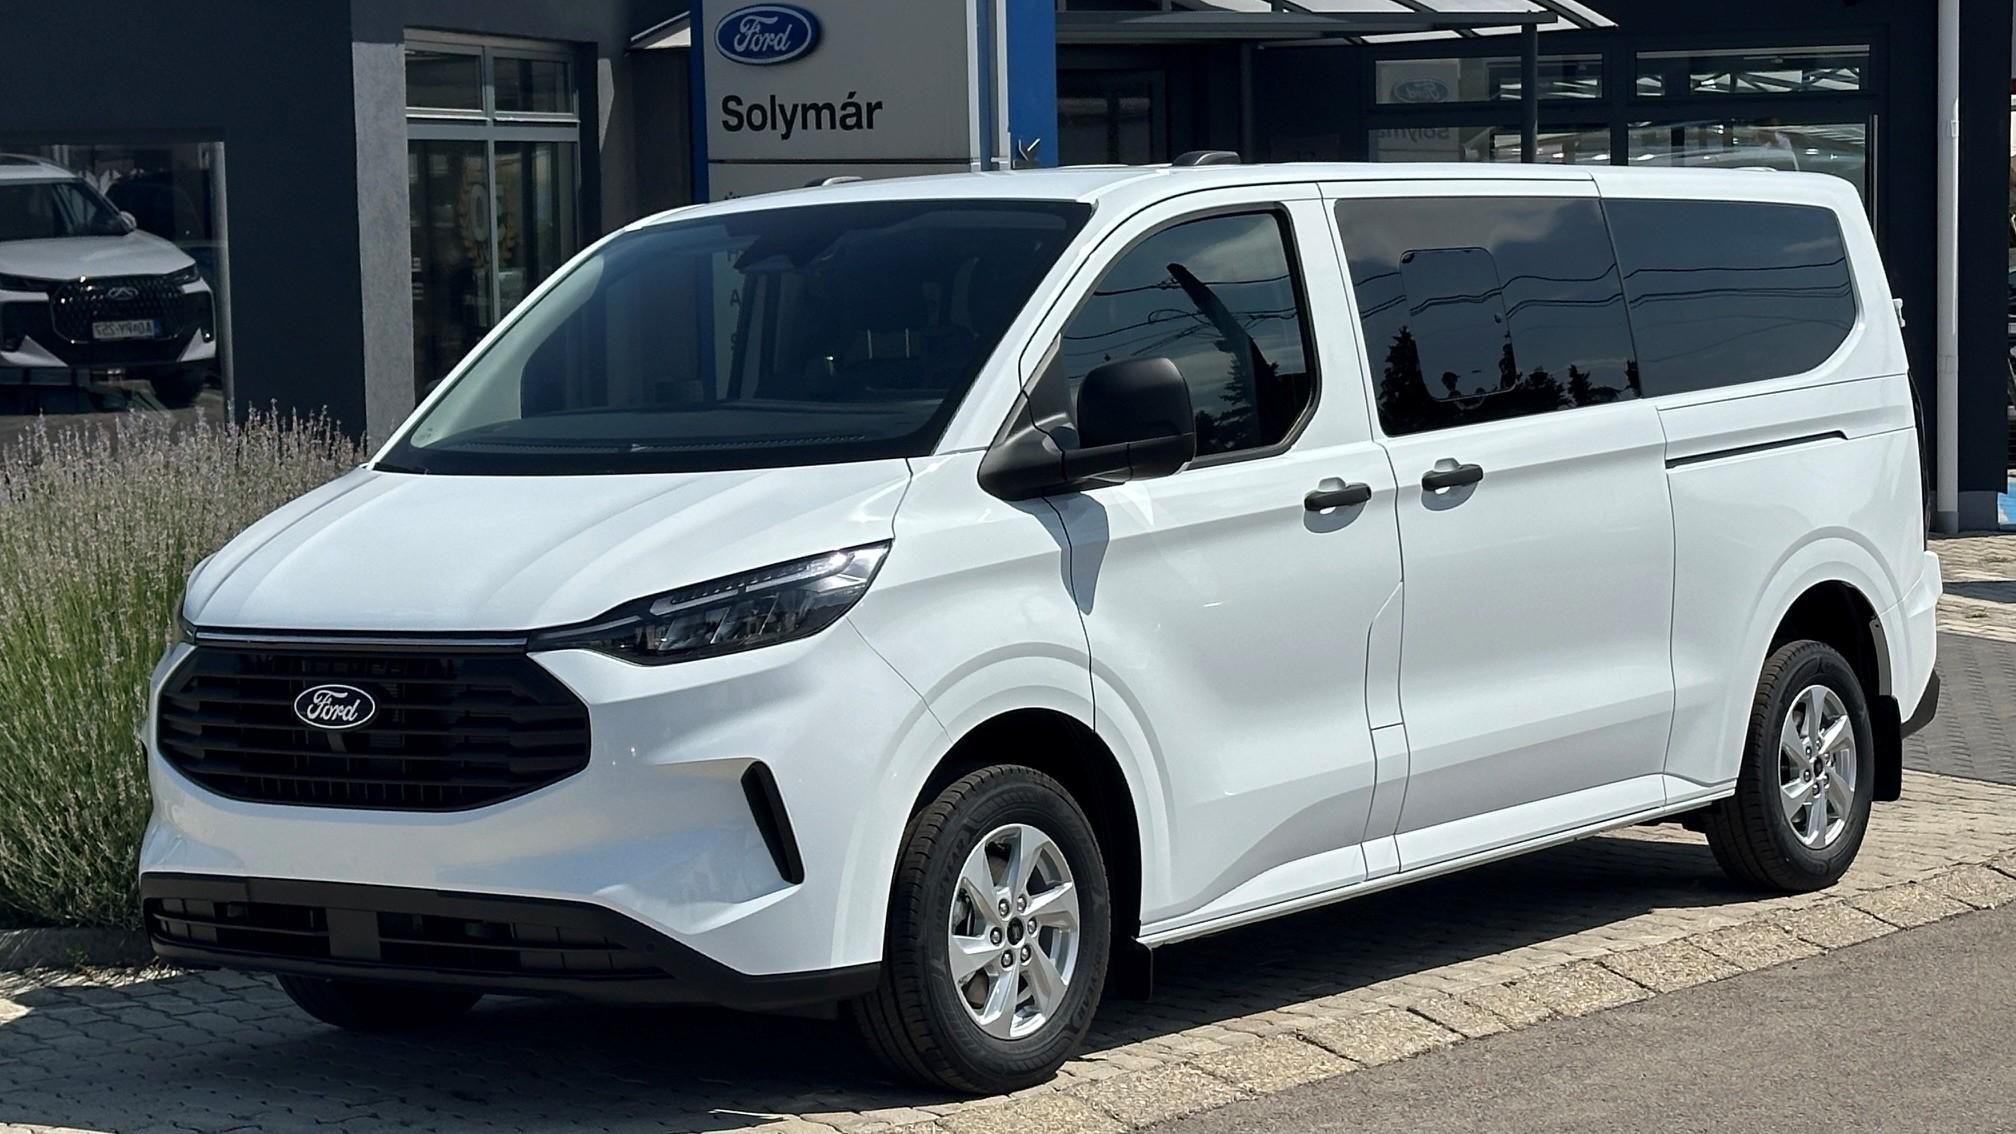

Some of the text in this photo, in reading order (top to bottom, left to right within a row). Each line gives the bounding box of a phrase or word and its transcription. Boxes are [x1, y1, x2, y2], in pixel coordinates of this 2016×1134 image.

[734, 15, 793, 52] Ford
[721, 91, 883, 140] Solymár
[306, 689, 361, 721] Ford
